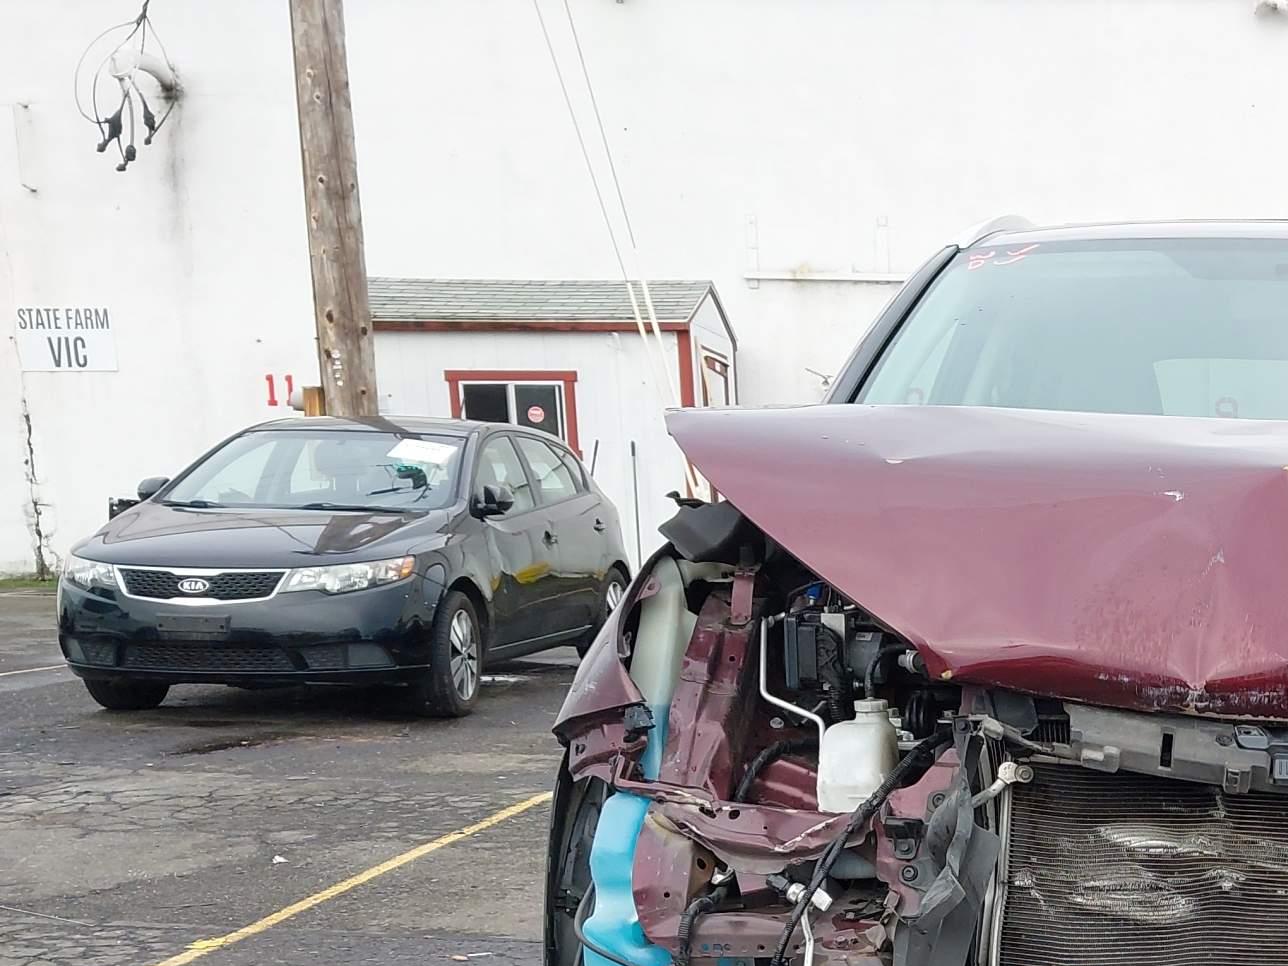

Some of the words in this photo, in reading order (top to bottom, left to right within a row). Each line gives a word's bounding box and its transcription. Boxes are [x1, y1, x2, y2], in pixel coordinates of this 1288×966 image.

[17, 307, 62, 330] STATE
[65, 307, 110, 330] FARM
[46, 336, 88, 368] VIC
[183, 581, 204, 590] KIA
